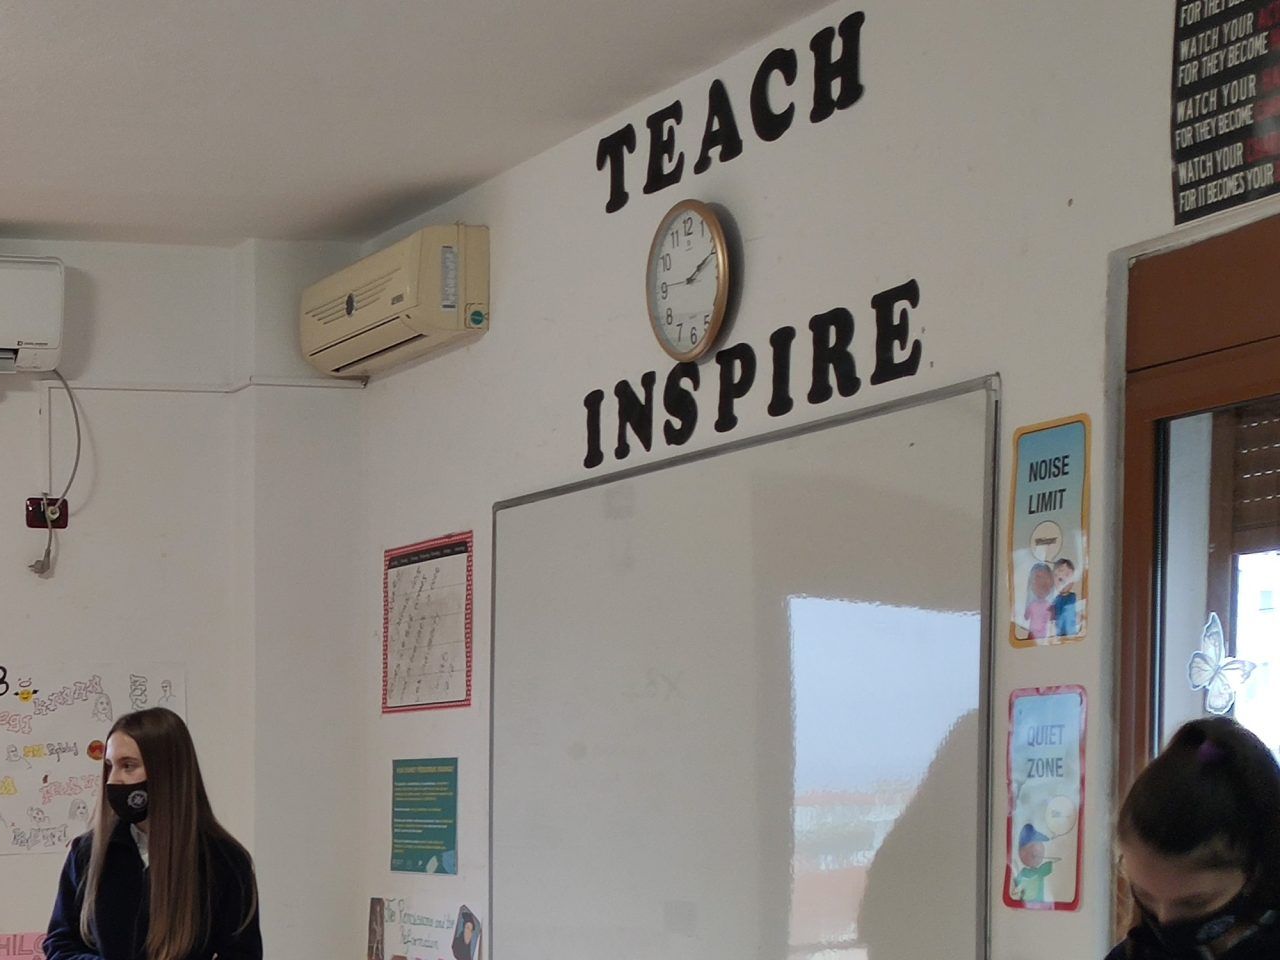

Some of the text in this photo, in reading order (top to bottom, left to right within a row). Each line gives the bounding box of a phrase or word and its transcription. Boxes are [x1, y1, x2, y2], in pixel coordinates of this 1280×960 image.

[1179, 1, 1201, 28] FOR
[1180, 25, 1220, 61] WATCH
[1223, 12, 1254, 44] YOUR
[1178, 61, 1199, 87] FOR
[1201, 48, 1227, 78] THEY
[1227, 31, 1269, 68] BECOME
[596, 10, 866, 214] TEACH
[1177, 87, 1218, 123] WATCH
[1222, 74, 1256, 106] YOUR
[1175, 126, 1194, 150] FOR
[1194, 117, 1217, 143] THEY
[1218, 104, 1254, 135] BECOME
[1178, 152, 1214, 186] WATCH
[1215, 142, 1244, 173] YOUR
[1179, 188, 1197, 213] FOR
[1198, 185, 1206, 207] IT
[1206, 172, 1245, 204] BECOMES
[1246, 163, 1274, 190] YOUR
[670, 230, 679, 248] 11
[682, 217, 693, 237] 12
[699, 220, 705, 237] 1
[660, 253, 671, 272] 10
[660, 282, 668, 300] 9
[666, 308, 673, 325] 8
[676, 323, 683, 342] 7
[690, 327, 697, 345] 6
[583, 279, 923, 469] INSPIRE
[1028, 454, 1070, 482] NOISE
[1028, 488, 1067, 515] LIMIT
[1027, 724, 1066, 747] QUIET
[1027, 757, 1064, 778] ZONE
